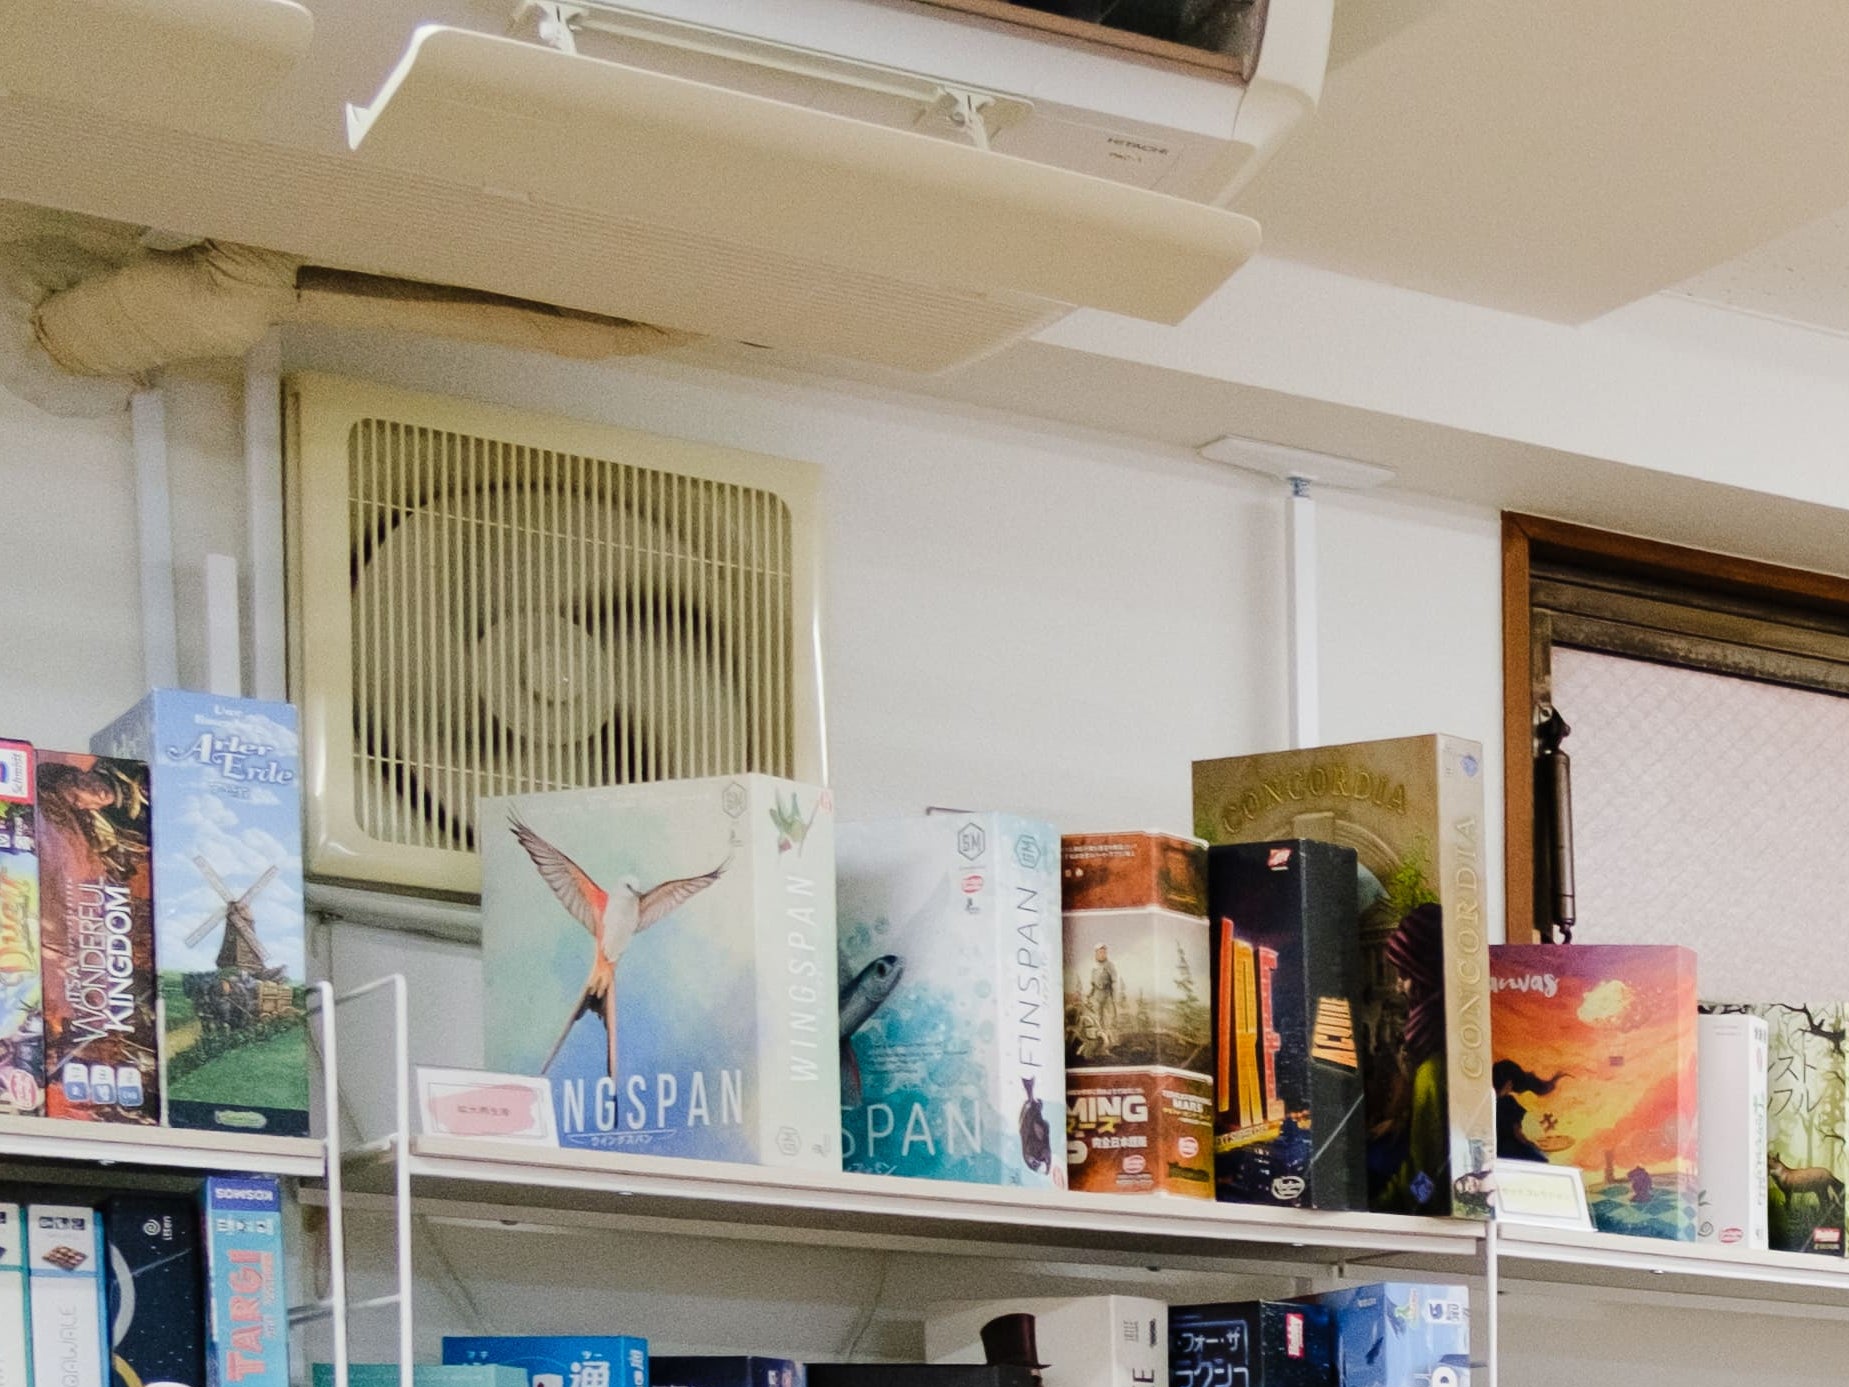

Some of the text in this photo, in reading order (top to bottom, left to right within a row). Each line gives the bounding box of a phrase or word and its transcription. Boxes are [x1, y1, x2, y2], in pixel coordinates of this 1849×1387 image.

[11, 753, 24, 795] Schmidt
[168, 734, 274, 764] Arler
[220, 759, 294, 785] Erde
[1222, 761, 1408, 834] CONCORDIA
[66, 966, 81, 980] A
[72, 878, 108, 1043] WONDERFUL
[104, 885, 135, 1033] KINGDOM
[786, 875, 820, 1081] WINGSPAN
[1016, 886, 1044, 1069] FINSPAN
[1453, 817, 1485, 1078] CONCORDIA
[1311, 997, 1357, 1070] ACQUIRE
[563, 1070, 743, 1132] NGSPAN
[214, 1187, 273, 1201] KOSMOS
[227, 1250, 263, 1382] TARGI
